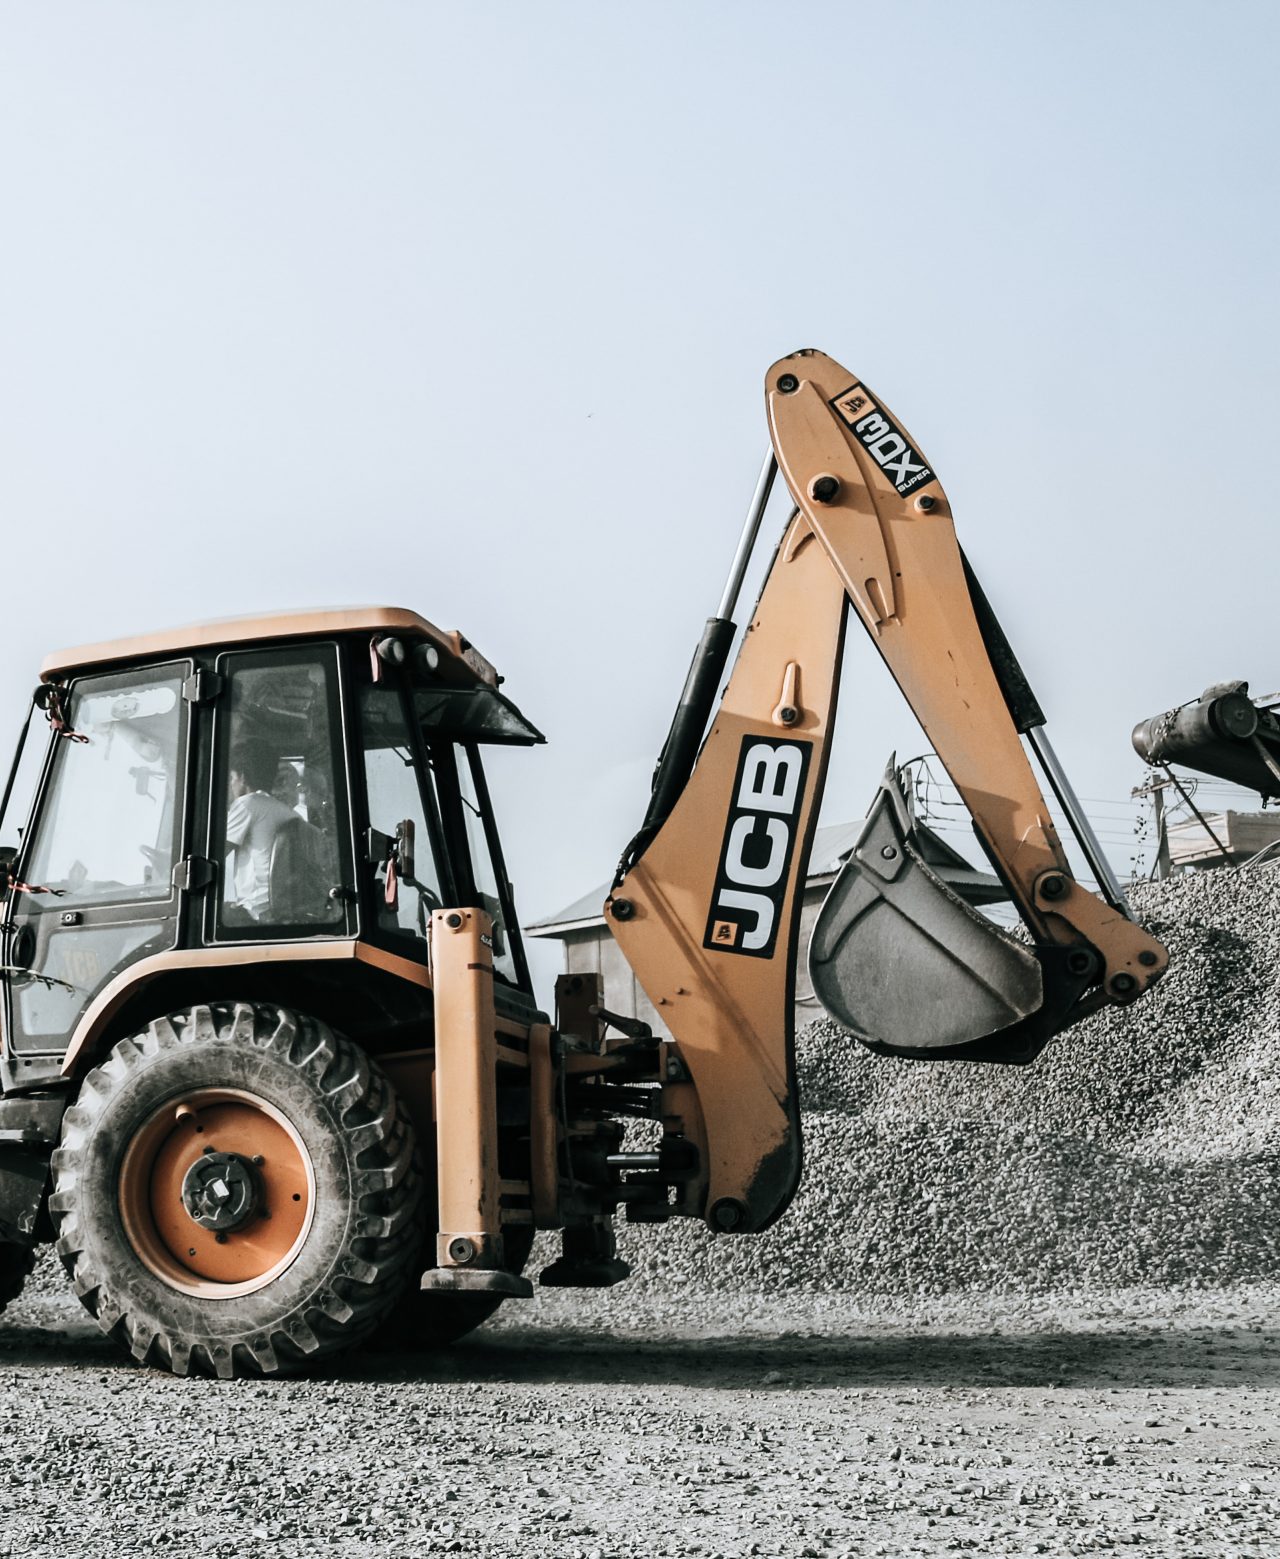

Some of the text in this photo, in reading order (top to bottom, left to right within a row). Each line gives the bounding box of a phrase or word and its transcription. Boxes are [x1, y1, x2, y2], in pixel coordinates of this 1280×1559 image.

[856, 413, 925, 486] 3DX
[897, 468, 931, 492] SUPER
[718, 743, 803, 950] JCB
